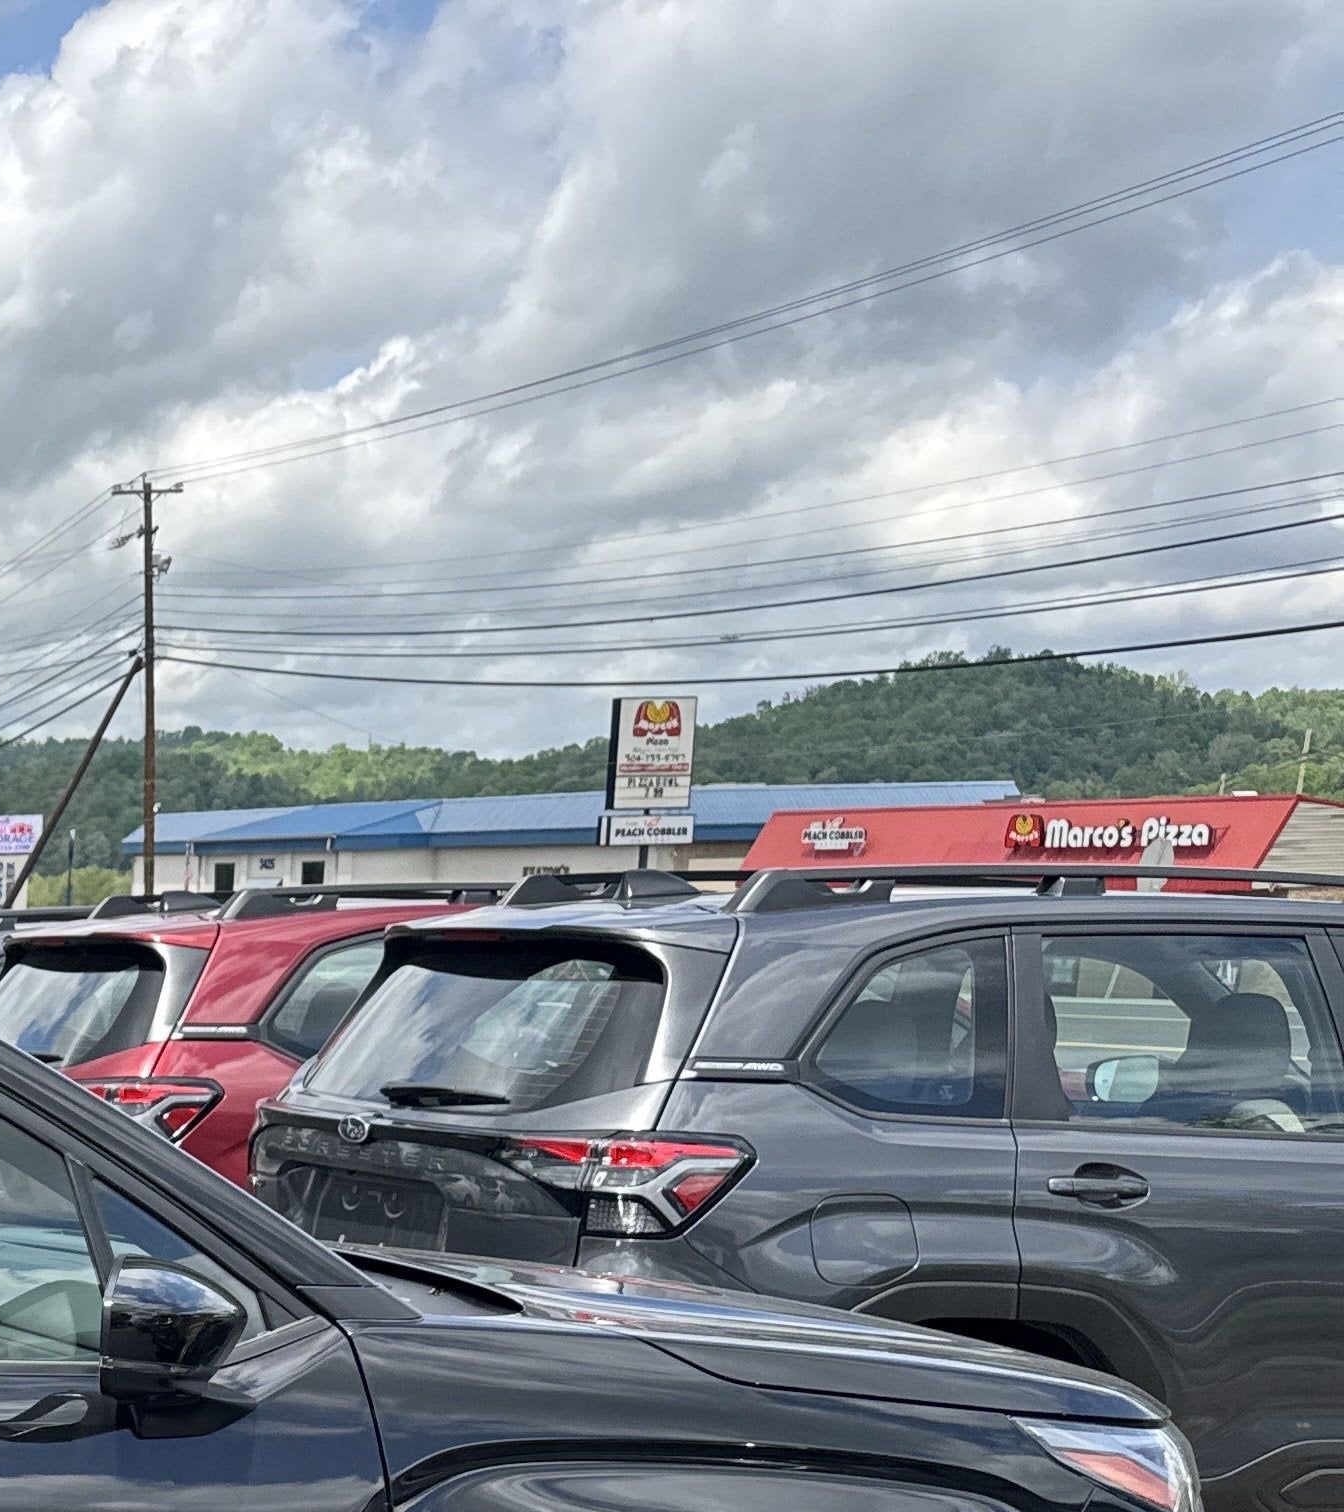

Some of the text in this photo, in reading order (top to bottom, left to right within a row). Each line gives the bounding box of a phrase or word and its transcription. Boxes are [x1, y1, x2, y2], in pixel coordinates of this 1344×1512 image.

[615, 826, 688, 838] PEACH COBBLER
[803, 830, 864, 840] PEACH COBBLER
[1045, 816, 1210, 848] Marco's Pizza
[742, 1062, 785, 1071] AWD
